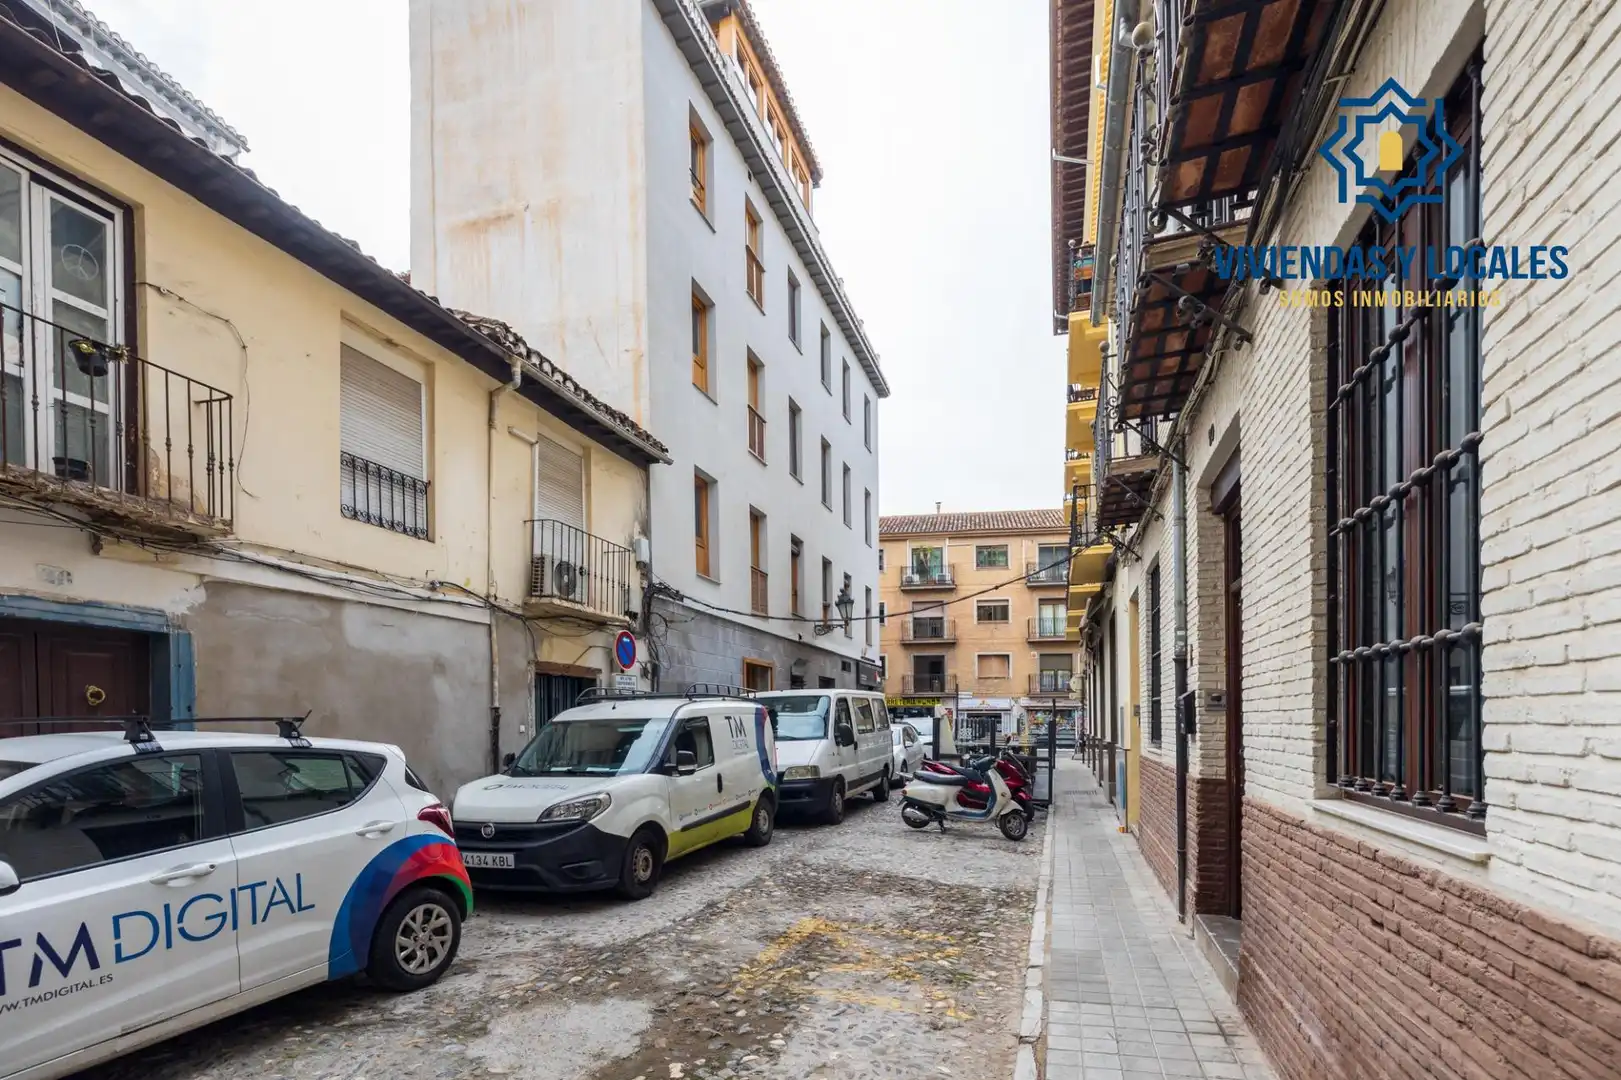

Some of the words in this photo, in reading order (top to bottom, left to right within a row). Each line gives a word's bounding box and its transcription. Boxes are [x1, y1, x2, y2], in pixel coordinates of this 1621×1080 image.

[724, 716, 746, 738] TM
[464, 854, 488, 866] 4134
[492, 857, 512, 867] KBL
[112, 873, 315, 964] DIGITAL
